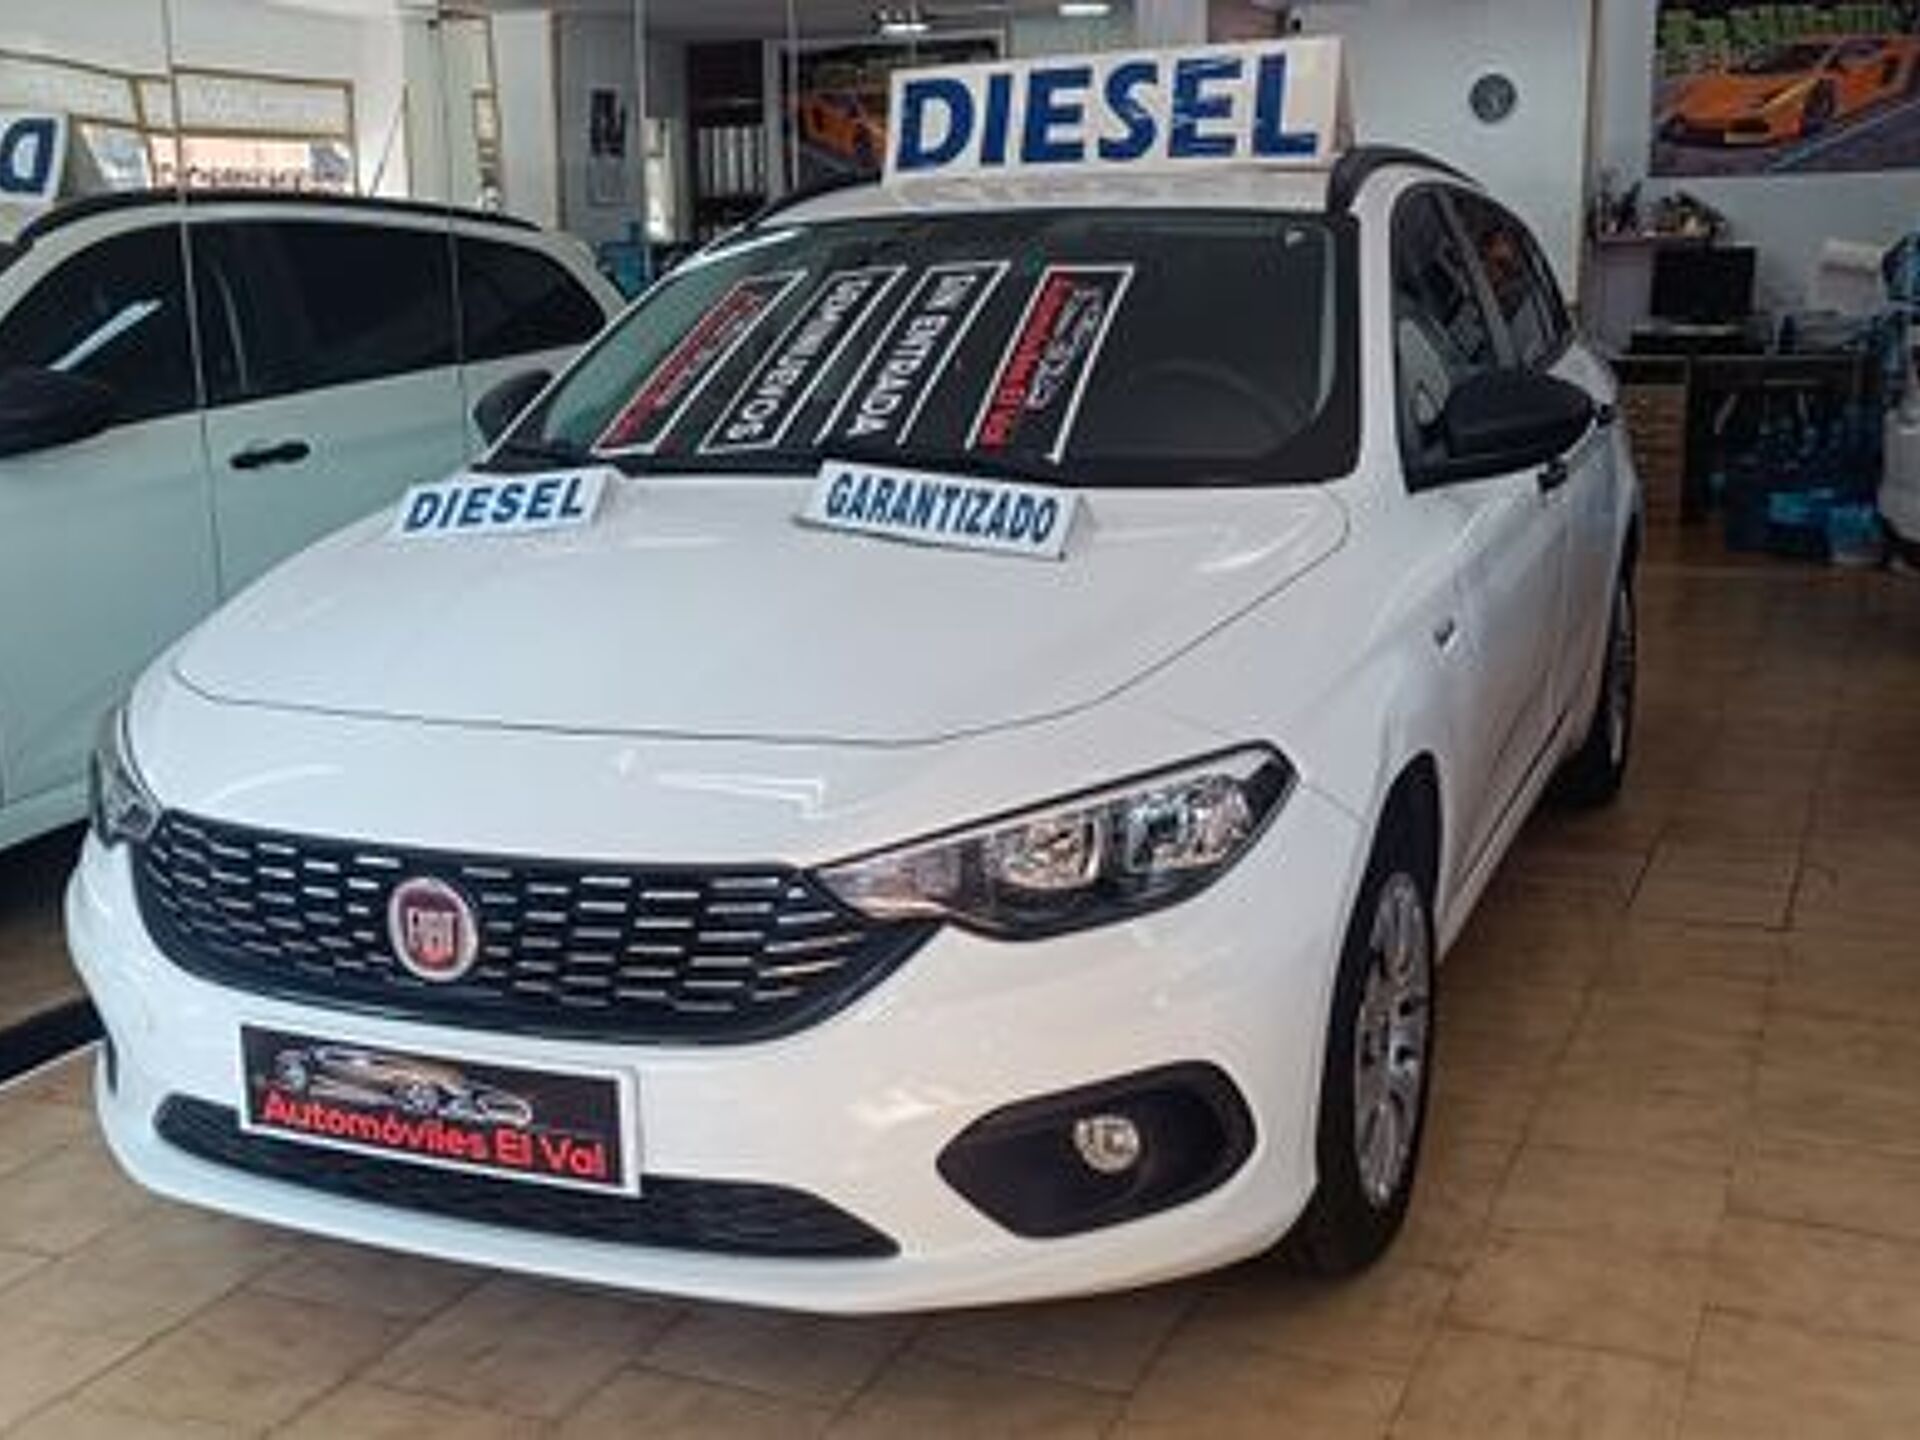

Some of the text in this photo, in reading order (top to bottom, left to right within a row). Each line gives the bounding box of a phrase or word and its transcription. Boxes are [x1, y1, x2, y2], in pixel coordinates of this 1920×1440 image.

[896, 53, 1317, 172] DIESEL
[846, 314, 948, 436] ENTRADA
[403, 477, 583, 533] DIESEL
[826, 472, 1059, 544] GARANTIZADO
[264, 1089, 606, 1177] Automóviles El Val
